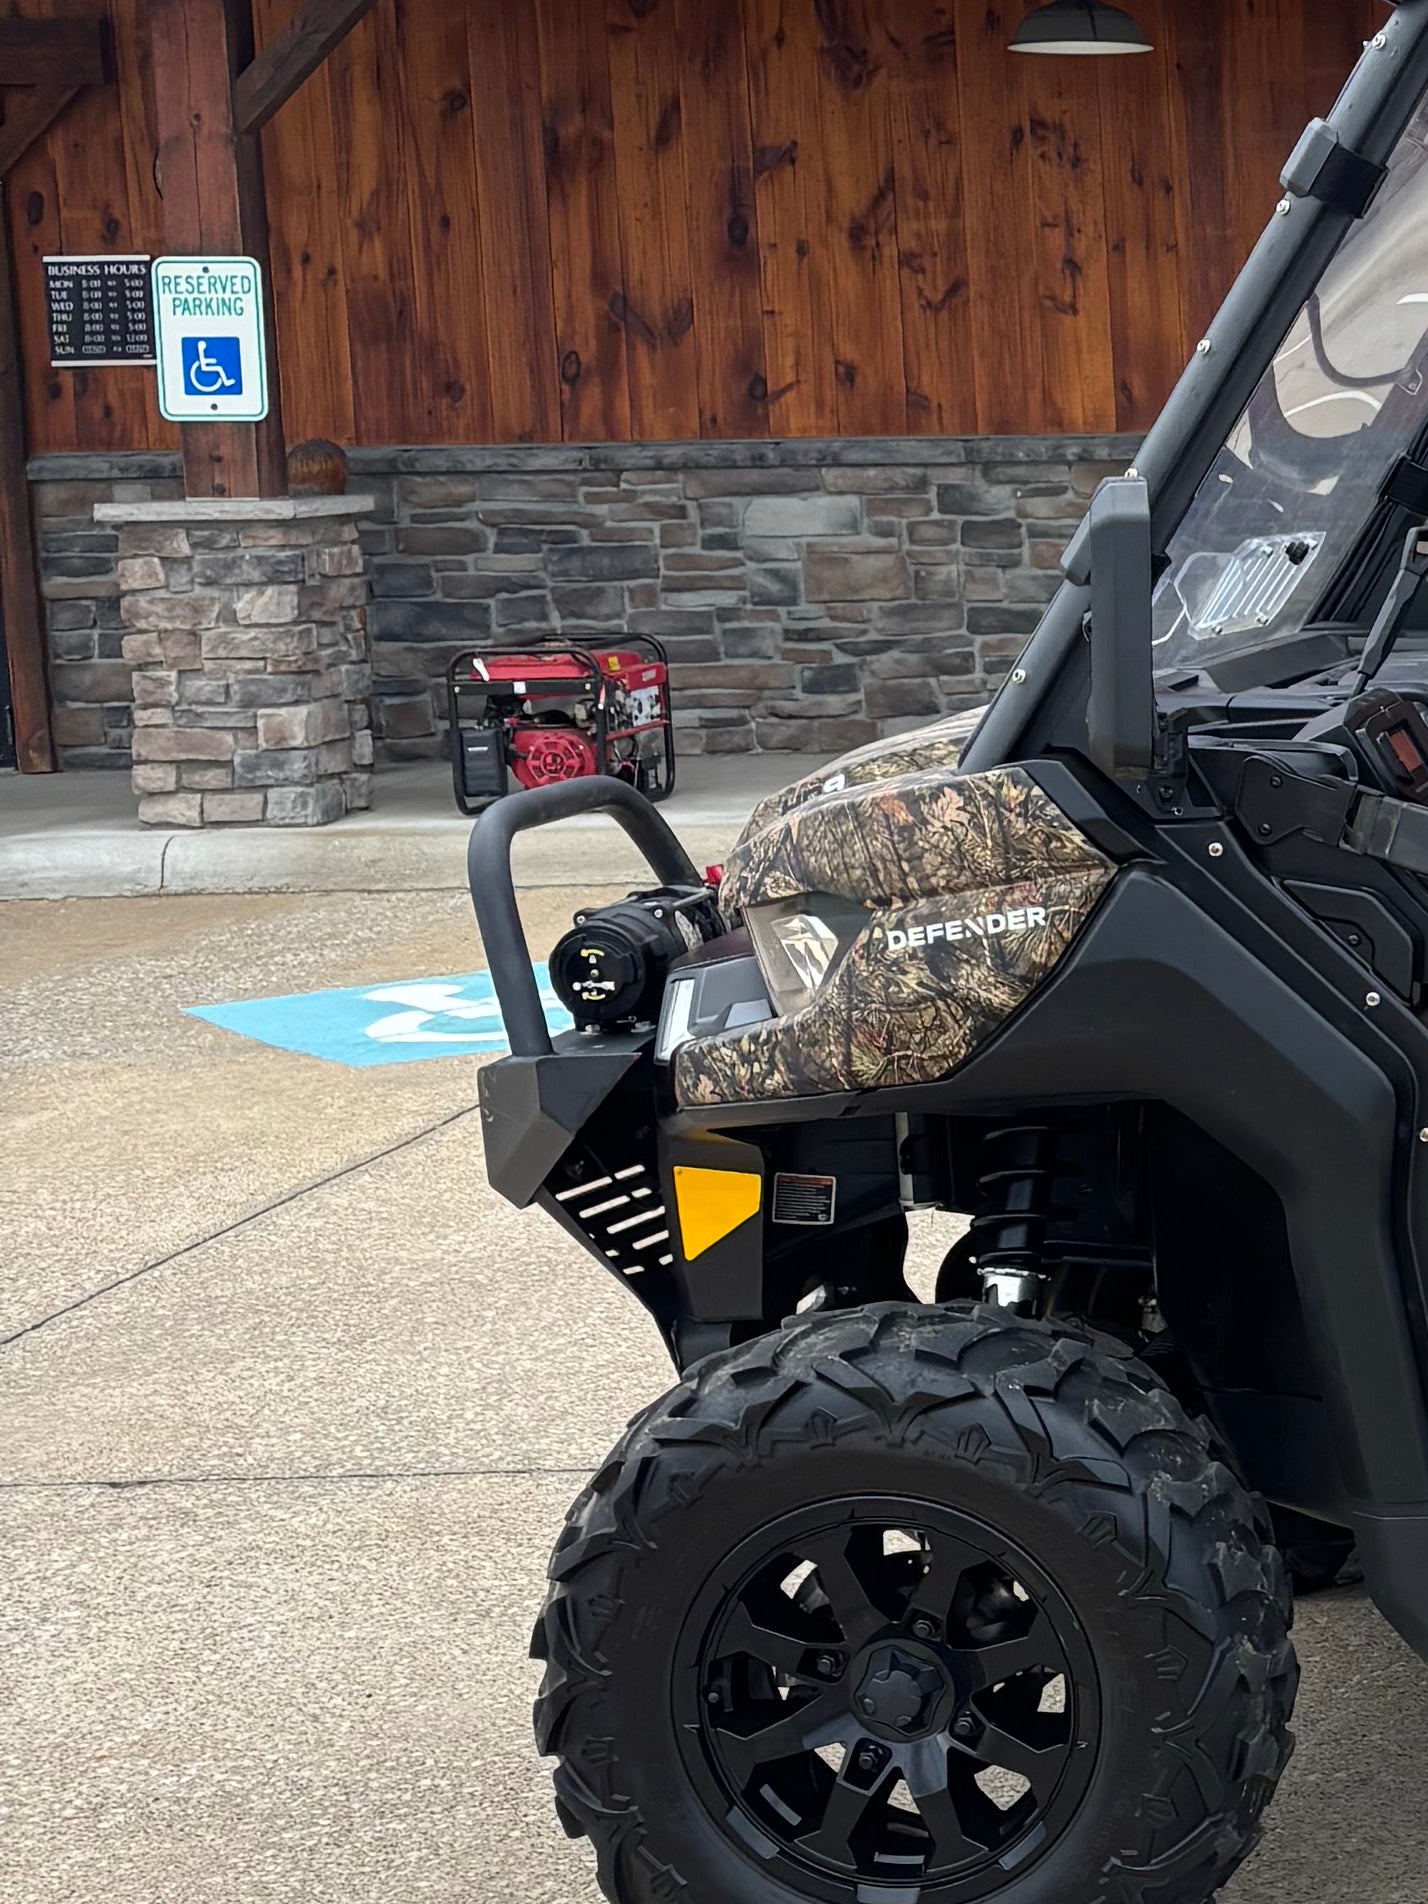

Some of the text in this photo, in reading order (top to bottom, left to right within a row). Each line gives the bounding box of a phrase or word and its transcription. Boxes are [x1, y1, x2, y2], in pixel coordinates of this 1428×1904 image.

[47, 264, 146, 276] BUSINESS HOURS
[161, 275, 252, 295] RESERVED
[172, 297, 245, 316] PARKING
[886, 906, 1047, 952] DEFENDER
